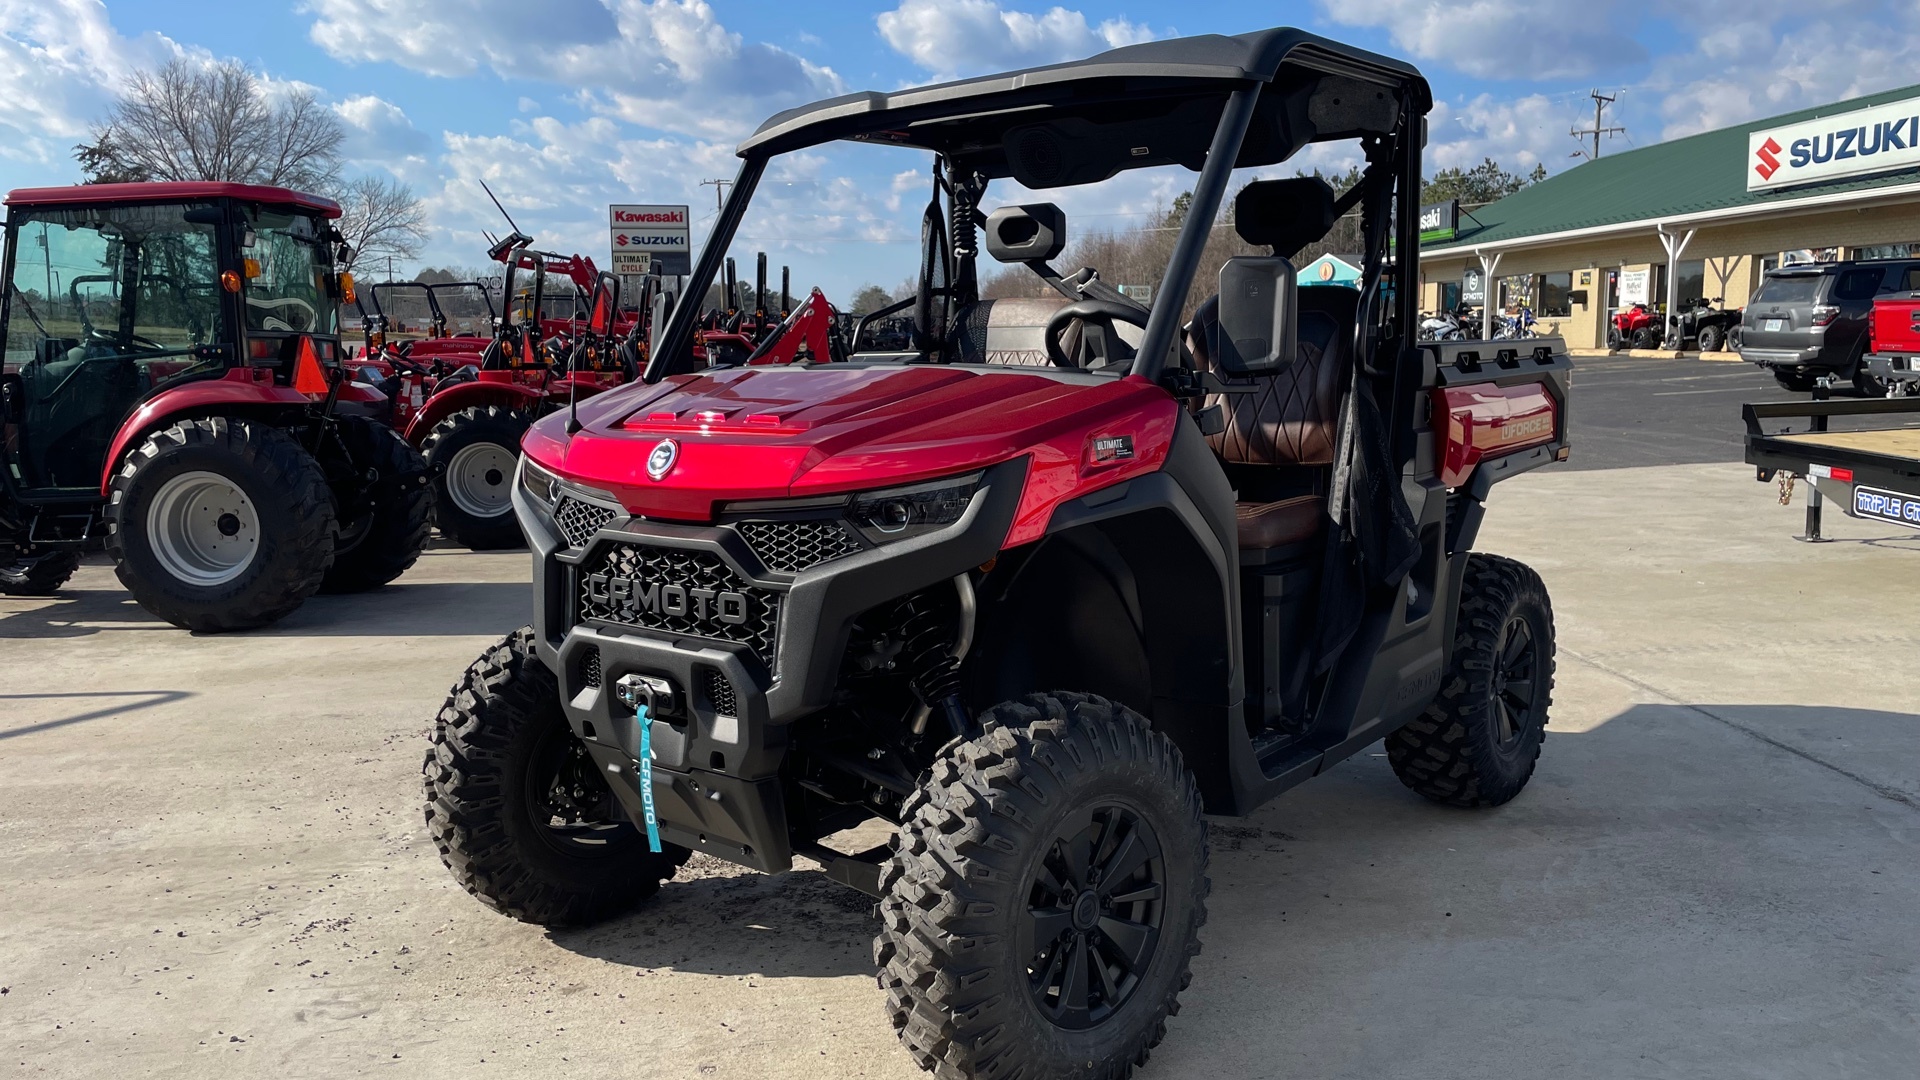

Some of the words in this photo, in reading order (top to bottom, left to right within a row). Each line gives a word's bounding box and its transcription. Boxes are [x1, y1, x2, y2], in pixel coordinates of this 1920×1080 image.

[1790, 116, 1919, 168] SUZUKI
[615, 211, 683, 222] Kawasaki
[1420, 207, 1440, 229] saki
[631, 236, 684, 245] SUZUKI
[1463, 292, 1484, 300] CFMOTO
[1501, 419, 1541, 440] UFORCE
[1097, 439, 1123, 450] ULTIMATE
[589, 573, 747, 625] CFMOTO
[641, 757, 656, 825] CFMOTO
